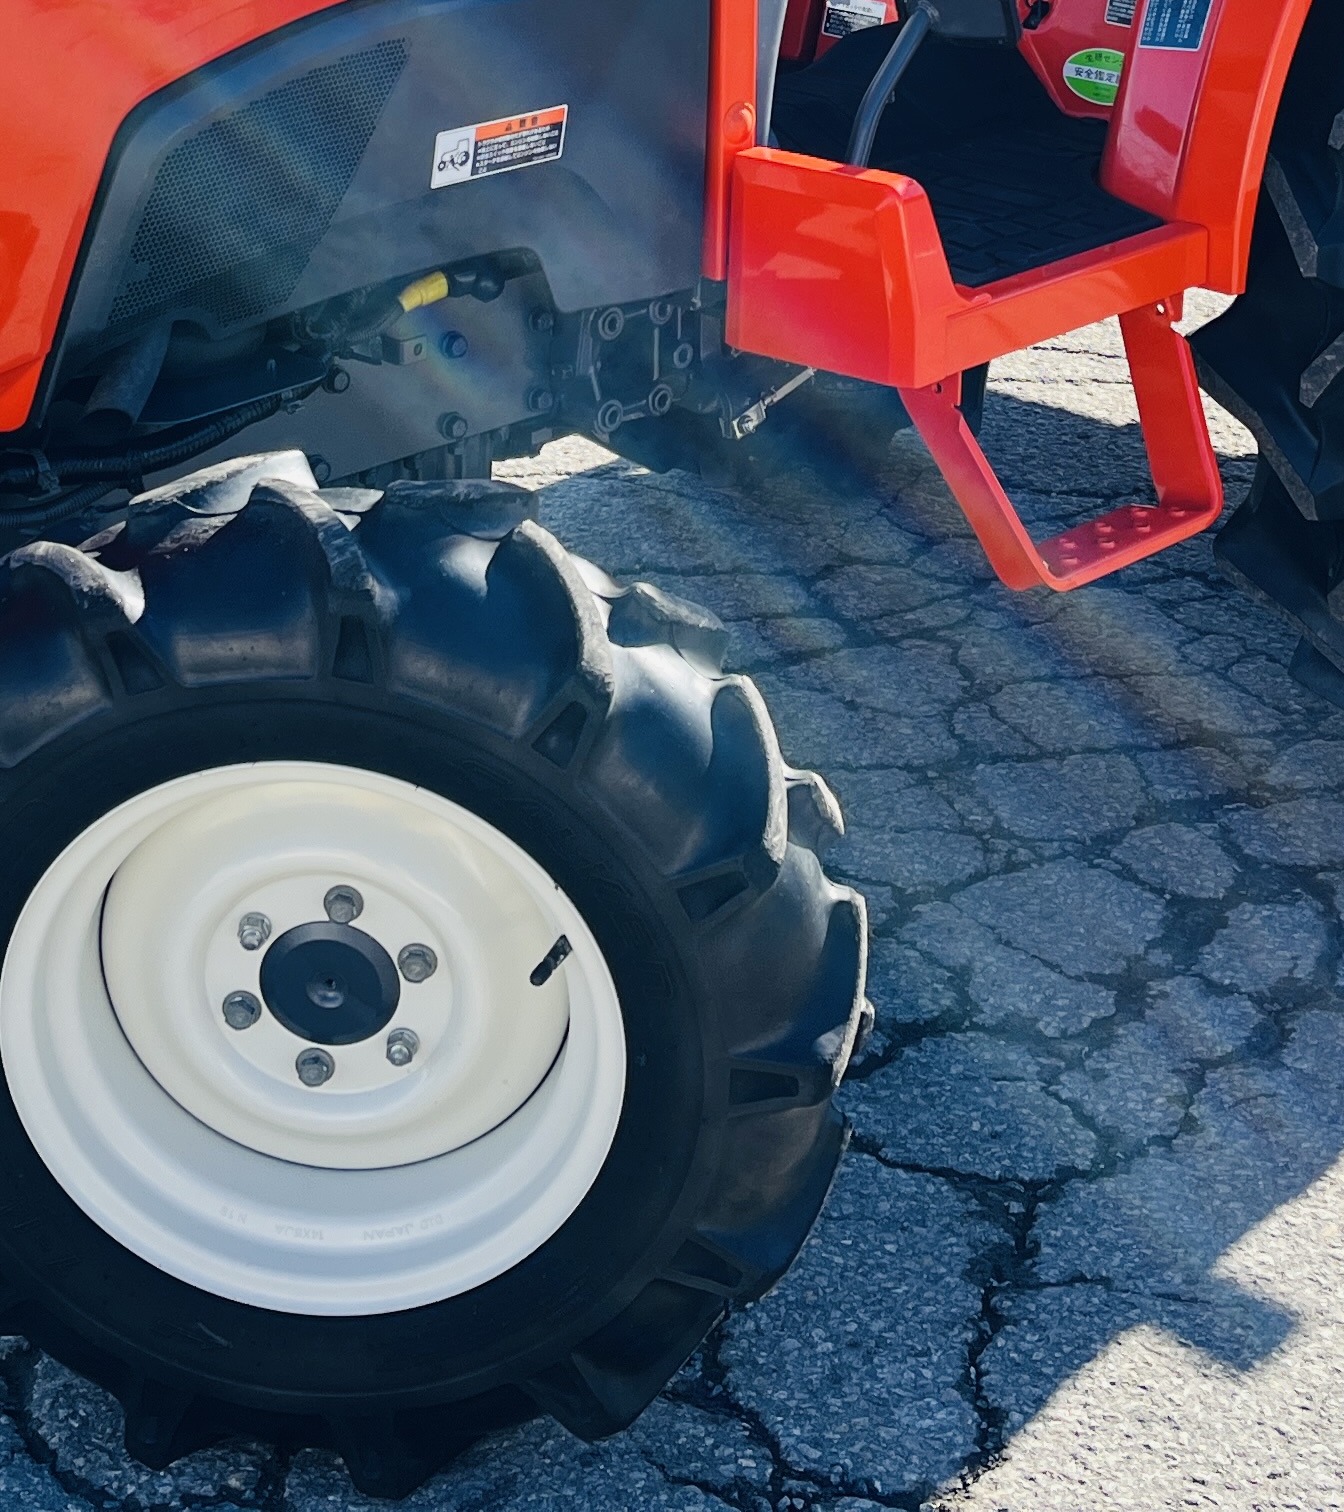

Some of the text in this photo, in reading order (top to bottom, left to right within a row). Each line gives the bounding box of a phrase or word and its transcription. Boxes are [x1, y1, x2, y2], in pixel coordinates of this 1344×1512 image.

[1074, 67, 1121, 84] 安全鑑定
[363, 1223, 414, 1240] JAPAN
